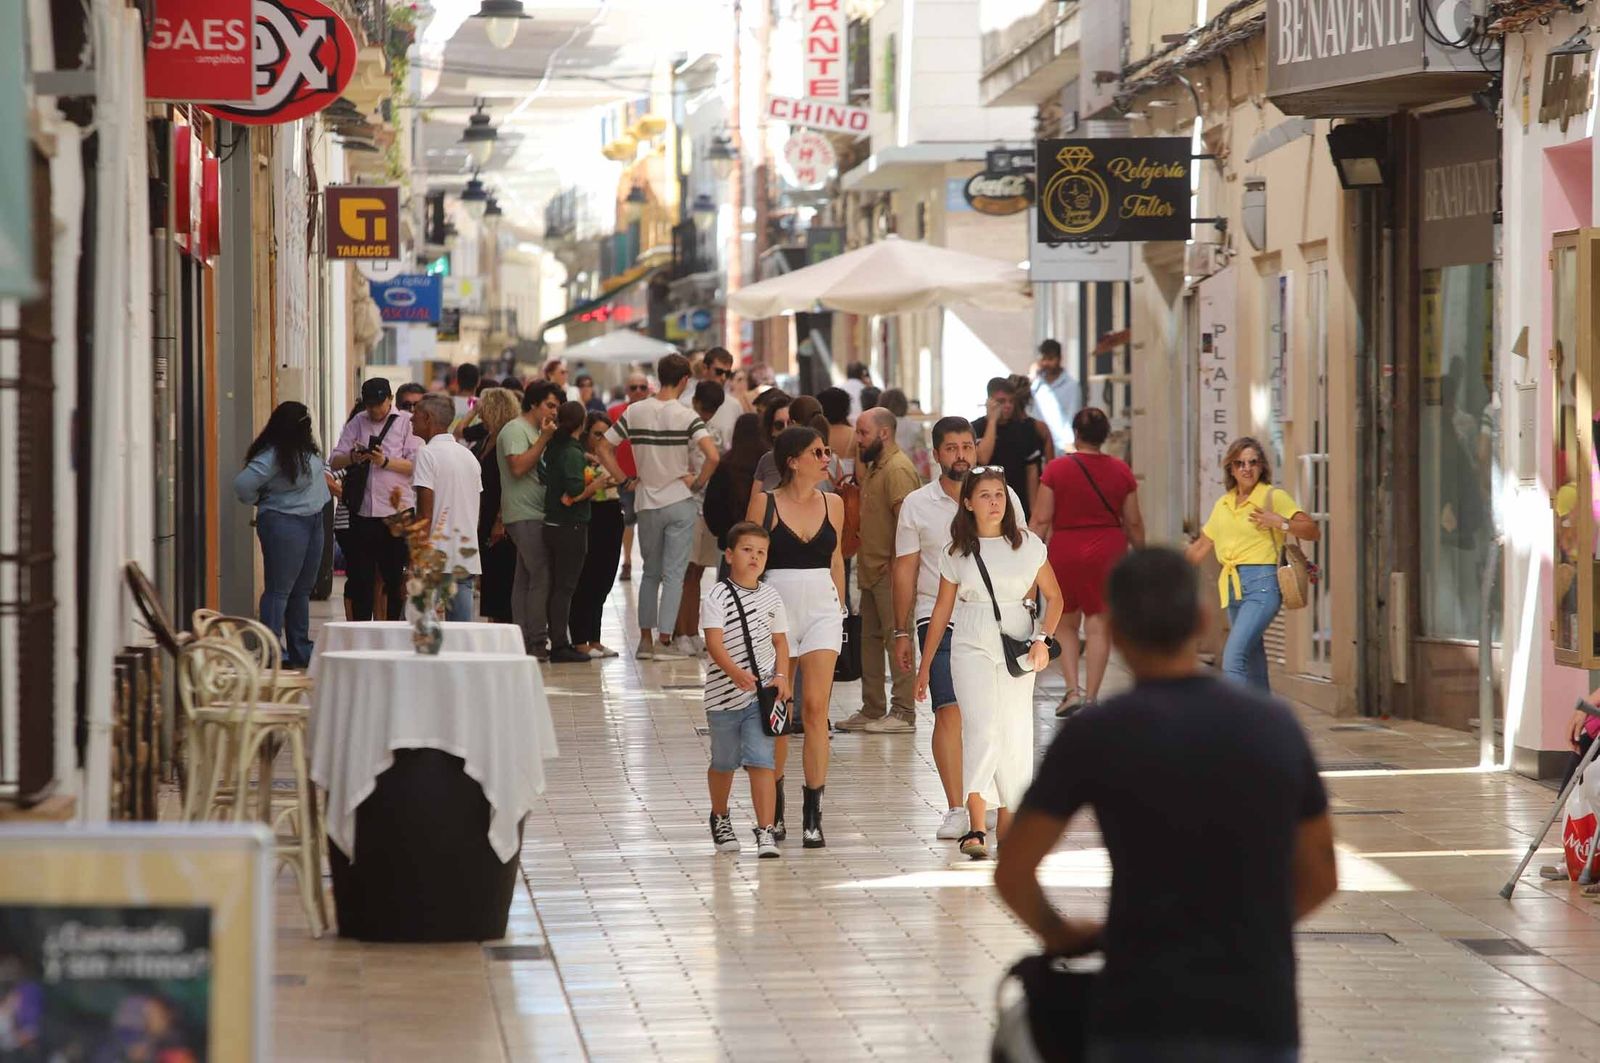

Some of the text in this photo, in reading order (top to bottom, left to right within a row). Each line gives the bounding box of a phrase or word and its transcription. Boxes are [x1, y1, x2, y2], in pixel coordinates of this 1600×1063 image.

[148, 18, 246, 51] GAES
[1277, 0, 1416, 66] BENAVENTE
[770, 99, 868, 131] CHINO
[1107, 156, 1187, 189] Relojería
[1119, 194, 1175, 219] Taller
[336, 245, 391, 257] TABACOS
